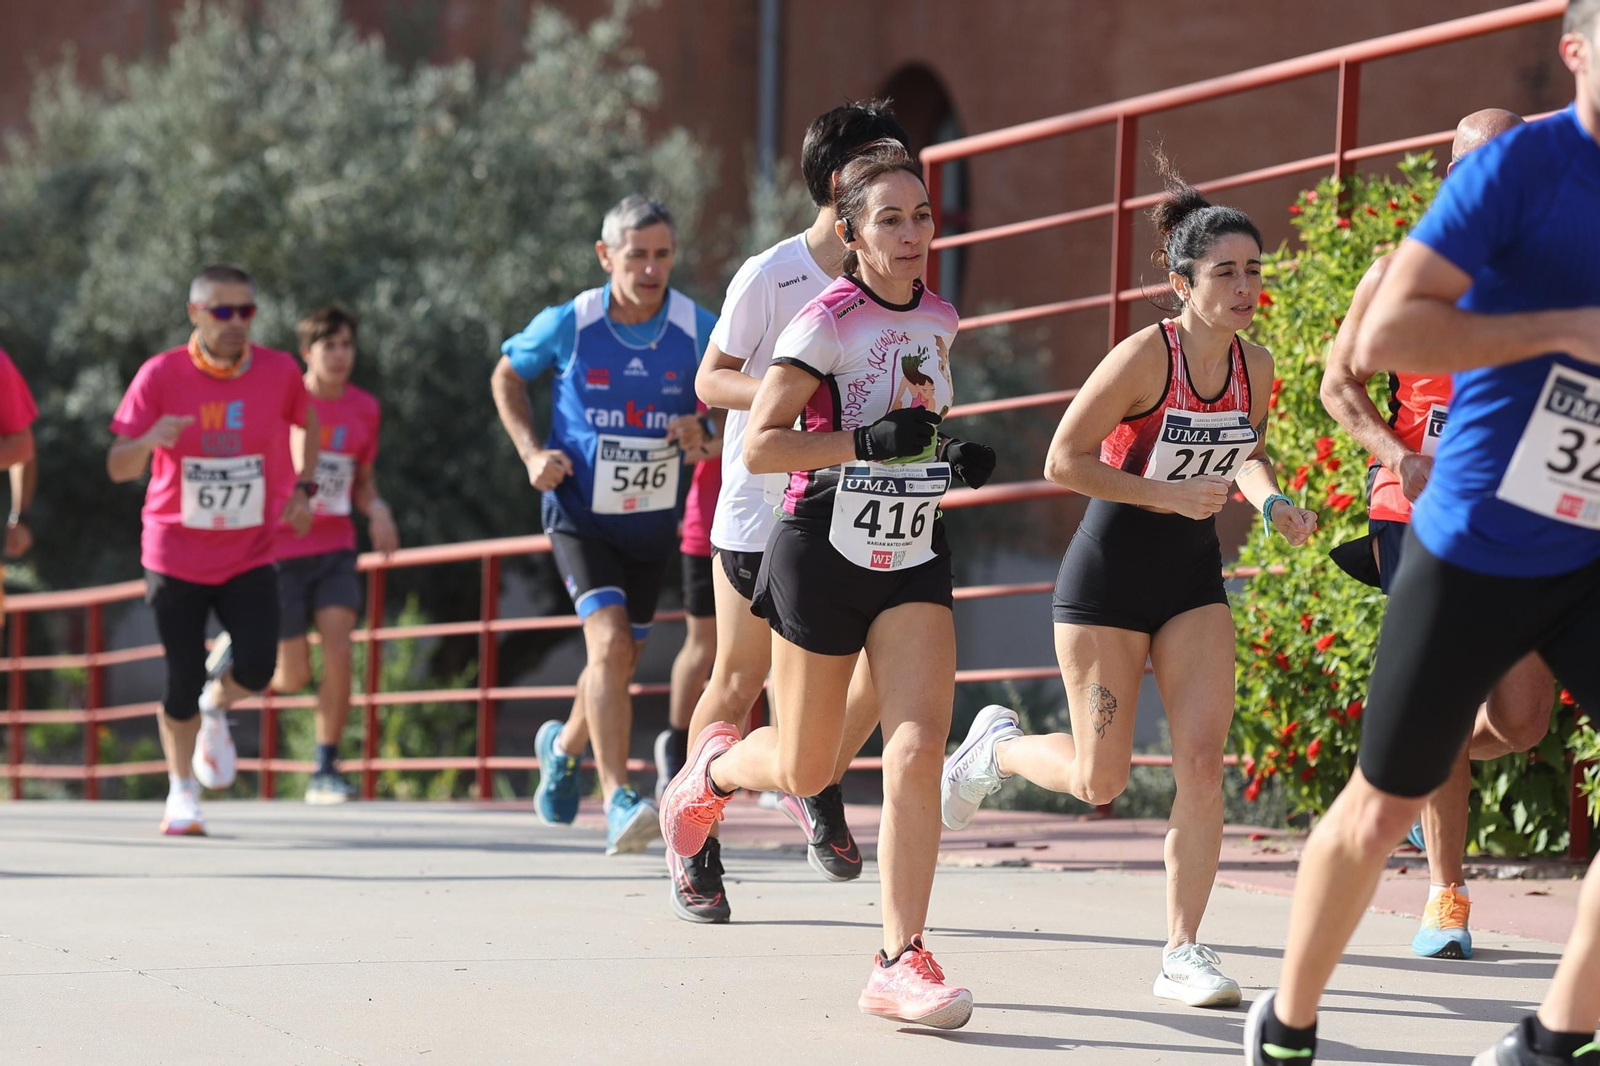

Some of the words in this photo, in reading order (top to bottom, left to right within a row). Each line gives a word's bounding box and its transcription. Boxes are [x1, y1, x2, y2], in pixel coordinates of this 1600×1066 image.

[202, 400, 244, 430] WE
[585, 400, 680, 428] rankin
[1167, 427, 1212, 443] UMA
[602, 447, 643, 462] UMA
[1167, 448, 1240, 481] 214
[611, 463, 667, 492] 546
[846, 478, 899, 494] UMA
[198, 483, 251, 509] 677
[853, 499, 930, 540] 416
[872, 554, 891, 565] WE
[948, 742, 985, 786] KIPRUN
